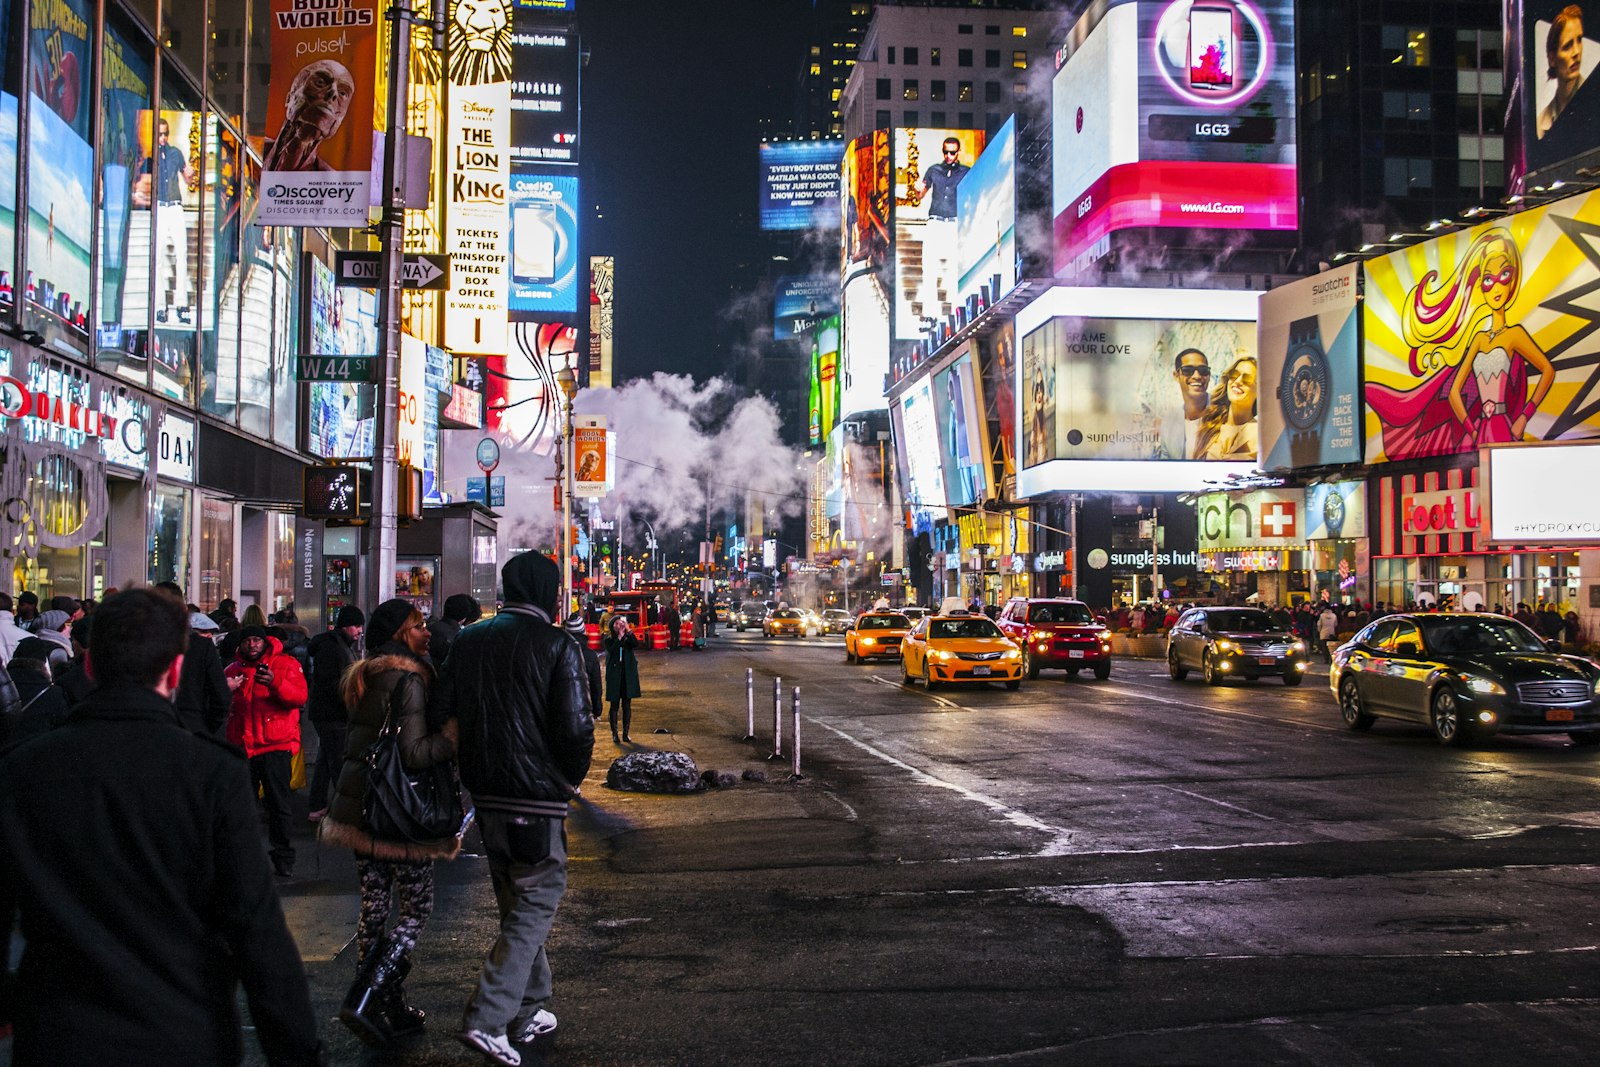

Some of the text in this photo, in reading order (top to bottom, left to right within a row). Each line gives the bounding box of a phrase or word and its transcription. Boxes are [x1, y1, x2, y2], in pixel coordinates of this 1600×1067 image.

[276, 8, 373, 29] WORLDS
[295, 36, 340, 58] pulse
[460, 100, 494, 116] Disney
[1195, 123, 1230, 136] LG G3
[462, 128, 492, 143] THE
[768, 174, 798, 182] MATILDA
[267, 185, 355, 203] Discovery
[266, 206, 364, 215] DISCOVERYTSX.COM
[456, 228, 499, 239] TICKETS
[459, 241, 496, 251] AT THE
[450, 252, 506, 263] MINSKOFF
[352, 262, 432, 279] ONE WAY
[453, 264, 500, 275] THEATRE
[465, 276, 489, 286] BOX
[1312, 278, 1344, 296] swatch
[458, 288, 496, 298] OFFICE
[1065, 332, 1106, 343] FRAME
[1065, 344, 1131, 355] YOUR LOVE
[302, 358, 367, 380] W 44 St
[1338, 394, 1352, 404] THE
[1333, 404, 1352, 415] BACK
[36, 391, 118, 441] OAKLEY
[1331, 416, 1352, 427] TELLS
[1086, 430, 1160, 445] sunglass hut
[1338, 428, 1352, 438] THE
[1330, 439, 1352, 449] STORY
[1403, 494, 1456, 532] Foot
[303, 528, 315, 589] Newsstand
[1110, 550, 1171, 569] sunglass
[1172, 550, 1196, 565] hut
[1223, 556, 1269, 568] swatch
